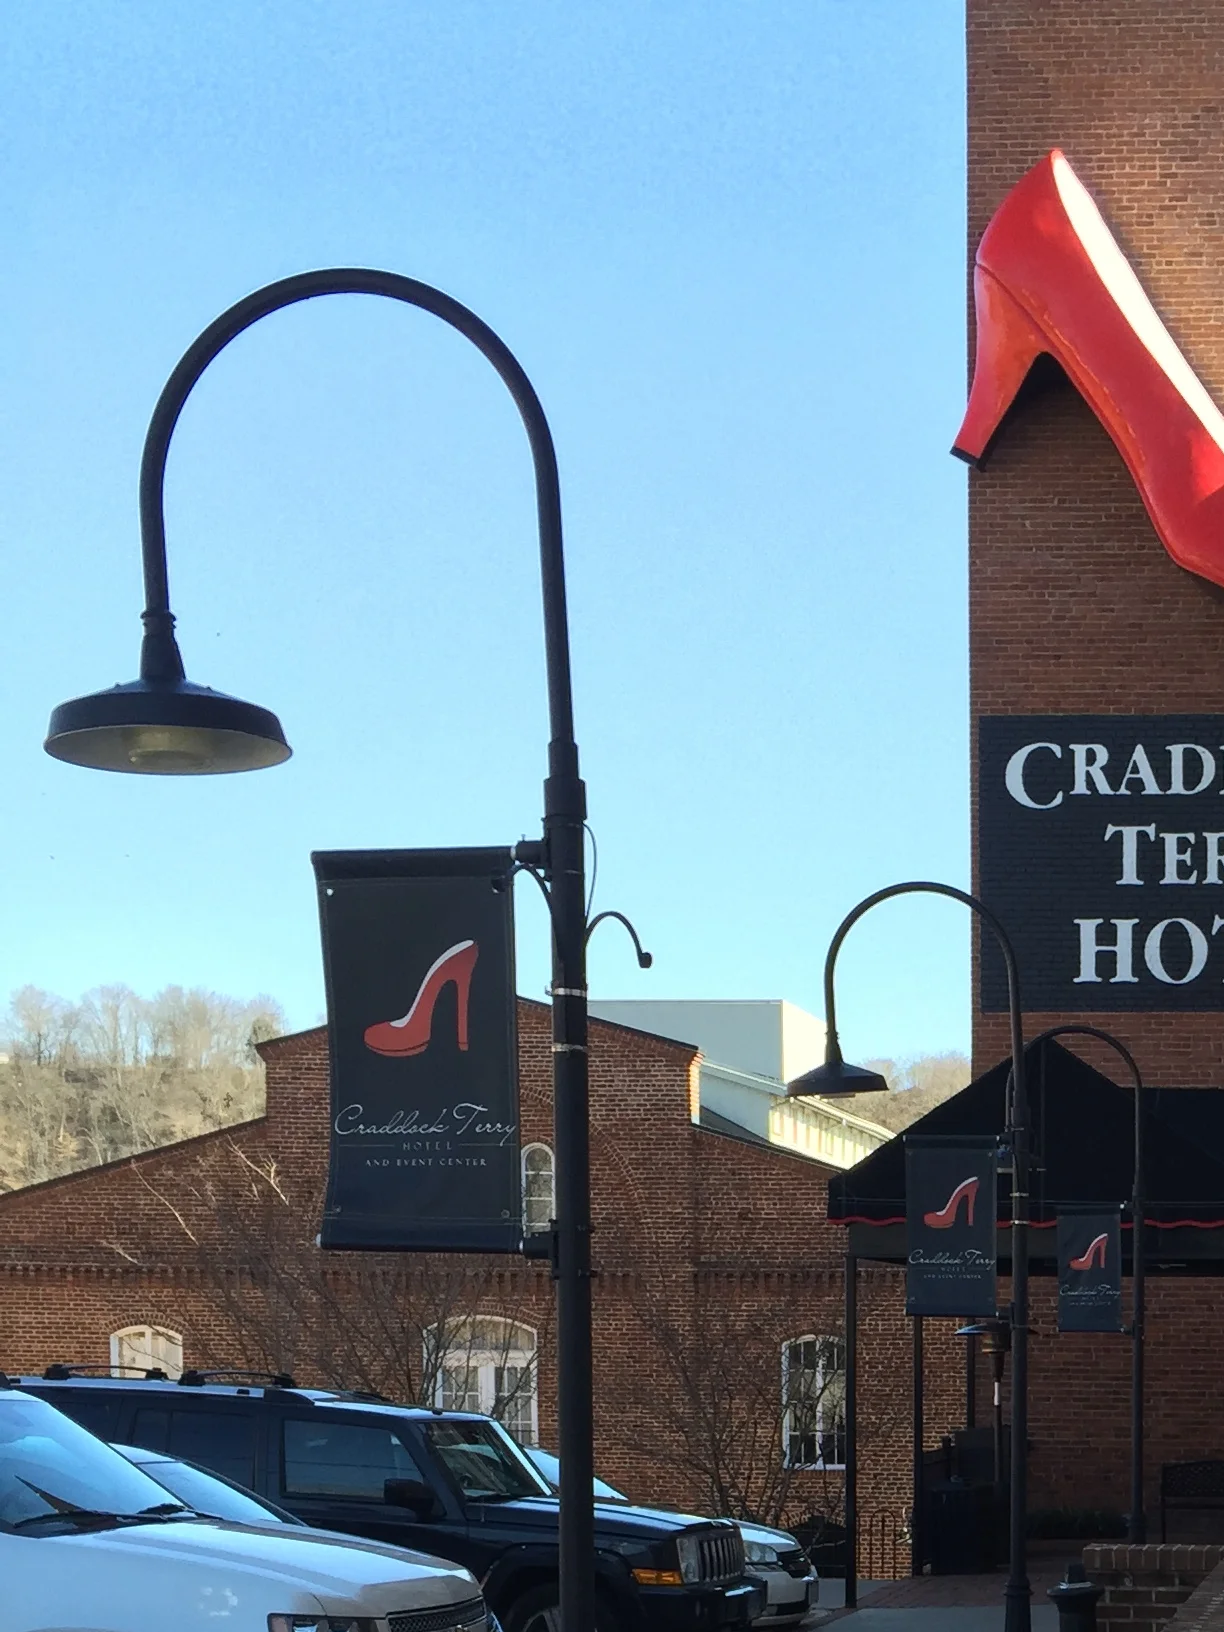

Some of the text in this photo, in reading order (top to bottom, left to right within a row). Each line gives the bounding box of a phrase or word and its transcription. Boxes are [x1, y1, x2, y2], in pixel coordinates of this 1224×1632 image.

[334, 1102, 517, 1147] Craddock Terry
[403, 1141, 453, 1152] HOTEL
[365, 1158, 488, 1168] AND EVENT CENTER
